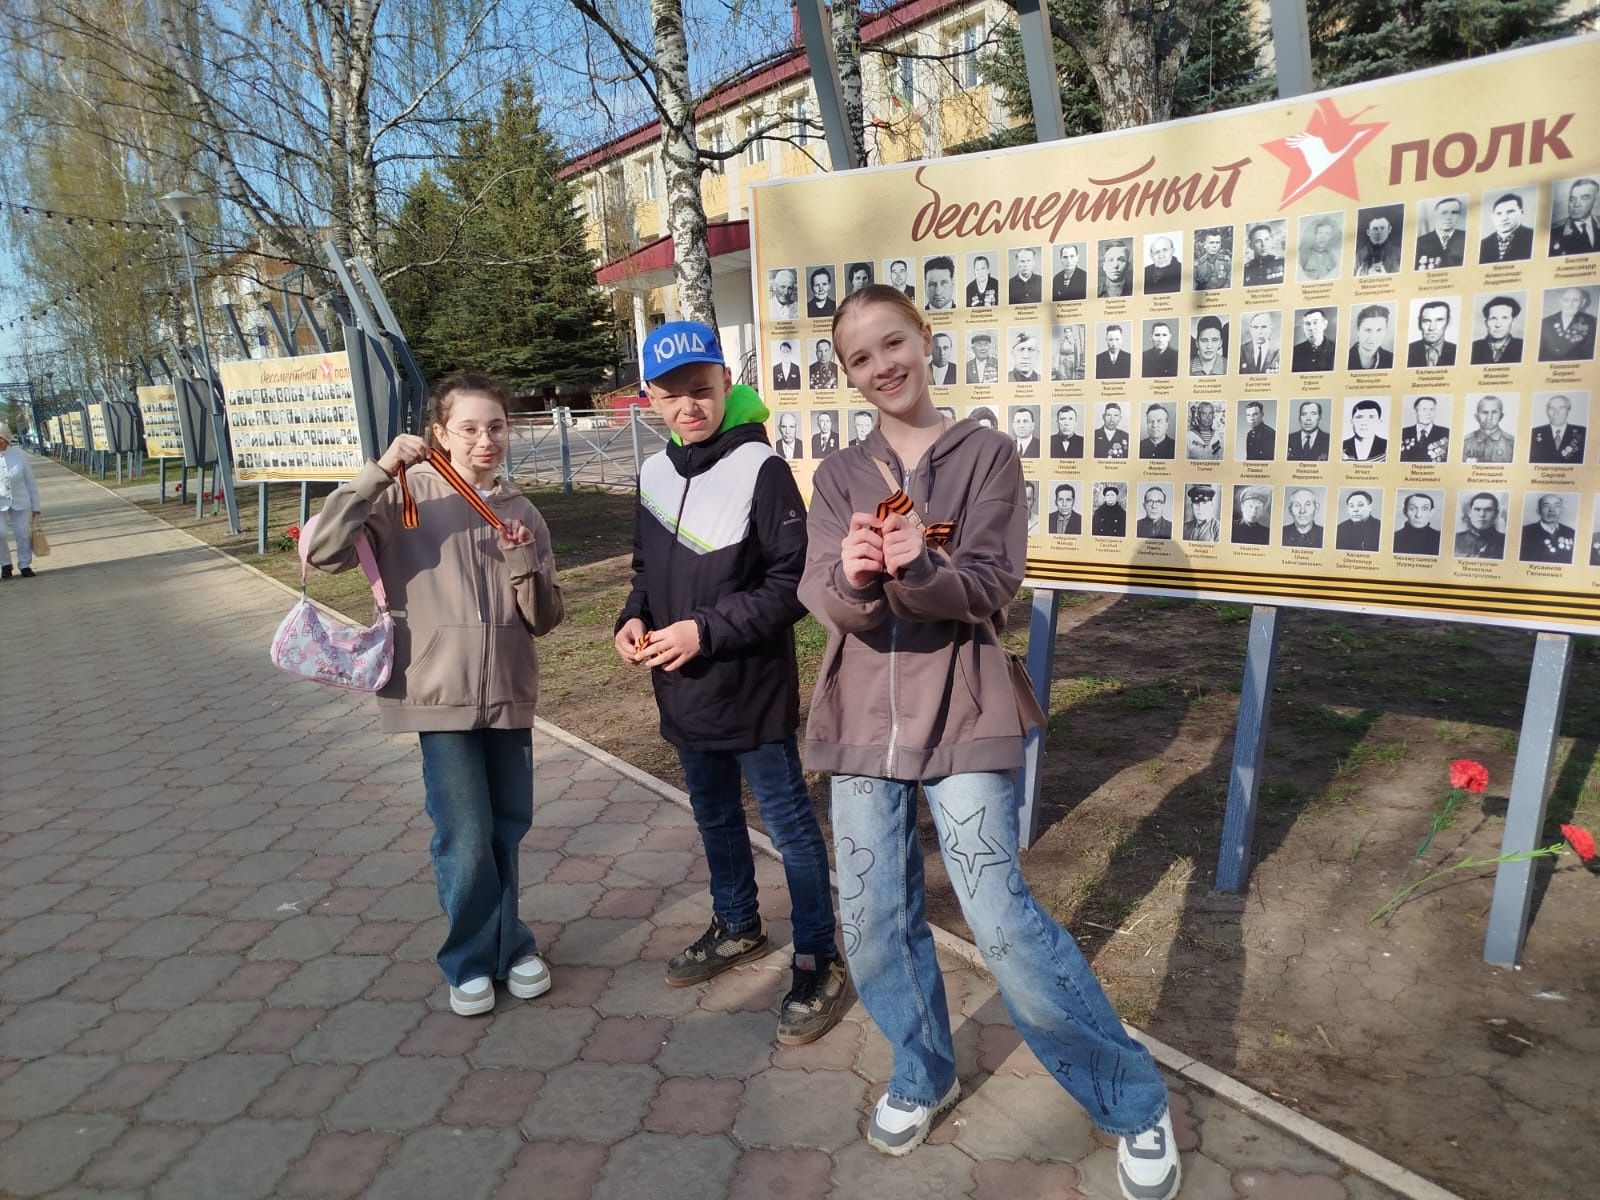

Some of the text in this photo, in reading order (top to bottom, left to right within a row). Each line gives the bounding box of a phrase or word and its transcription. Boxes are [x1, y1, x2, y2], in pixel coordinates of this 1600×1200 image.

[911, 155, 1253, 243] бессмертный
[653, 332, 706, 363] ЮИД
[853, 780, 874, 796] NO
